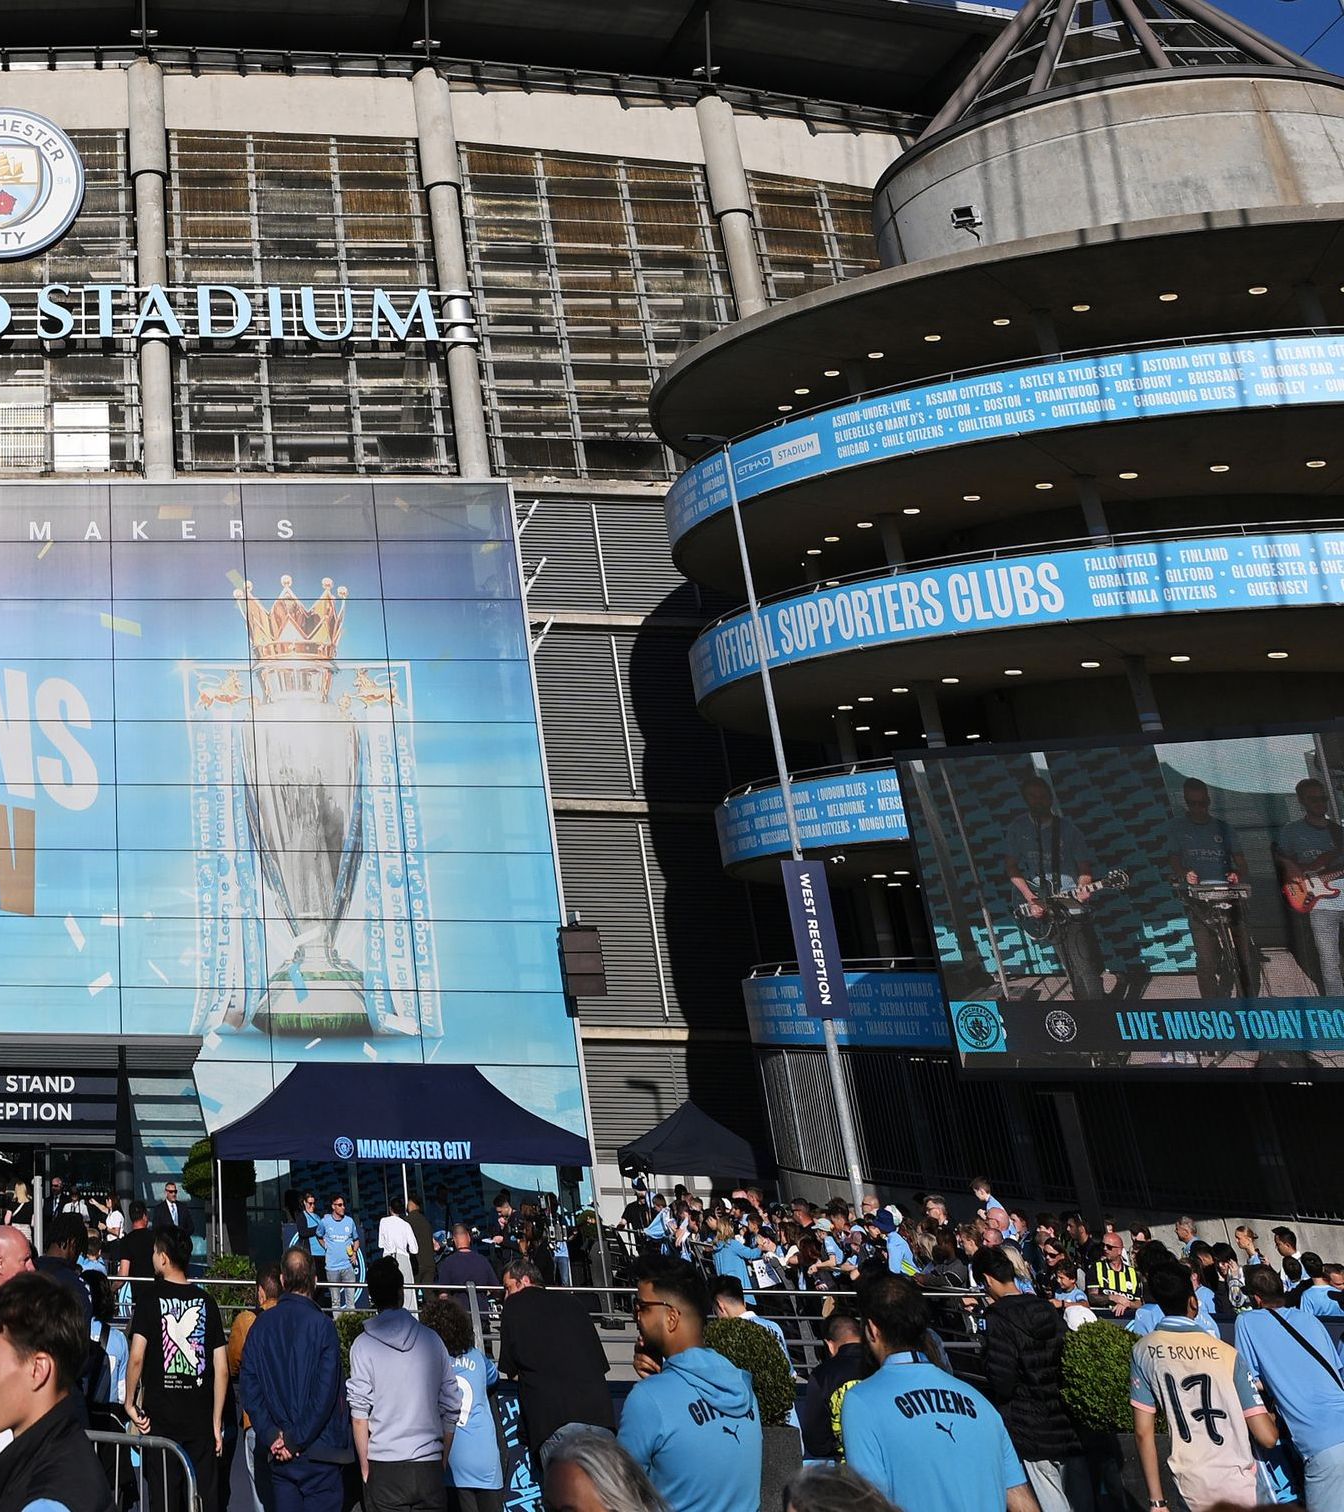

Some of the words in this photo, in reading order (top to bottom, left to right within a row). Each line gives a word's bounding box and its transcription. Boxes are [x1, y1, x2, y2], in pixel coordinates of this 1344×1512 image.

[35, 283, 441, 342] STADIUM
[832, 399, 911, 428] ASHTON-UNDER-LYNE
[925, 389, 958, 408] ASSAM
[959, 381, 1003, 401] CITYZENS
[1019, 372, 1055, 390] ASTLEY
[1058, 370, 1066, 384] &
[1067, 362, 1123, 383] TYLDESLEY
[1142, 356, 1189, 373] ASTORIA
[1192, 354, 1217, 368] CITY
[1220, 350, 1256, 366] BLUES
[1275, 344, 1325, 361] ATLANTA
[834, 423, 875, 445] BLUEBELLS
[884, 415, 908, 433] MARY
[936, 405, 971, 422] BOLTON
[983, 395, 1022, 412] BOSTON
[1035, 383, 1100, 404] BRANTWOOD
[1115, 375, 1172, 392] BREDBURY
[1188, 368, 1245, 385] BRISBANE
[1261, 363, 1307, 379] BROOKS
[1310, 362, 1334, 376] BAR
[837, 440, 871, 459] CHICAGO
[881, 431, 905, 449] CHILE
[958, 414, 1003, 434] CHILTERN
[1004, 408, 1036, 427] BLUES
[1051, 398, 1116, 419] CHITTAGONG
[1133, 390, 1197, 409] CHONGQING
[1200, 384, 1236, 401] BLUES
[1254, 381, 1306, 397] CHORLEY
[736, 455, 771, 477] ETIHAD
[777, 440, 815, 461] STADIUM
[28, 519, 296, 541] MAKERS
[1084, 552, 1158, 572] FALLOWFIELD
[1179, 547, 1229, 564] FINLAND
[1251, 543, 1301, 559] FLIXTON
[1088, 571, 1149, 590] GIBRALTAR
[1165, 567, 1214, 583] GILFORD
[1232, 561, 1306, 579] GLOUCESTER
[1092, 589, 1159, 608] GUATEMALA
[1163, 585, 1218, 602] CITYZENS
[1247, 580, 1309, 597] GUERNSEY
[777, 577, 945, 656] SUPPORTERS
[948, 562, 1065, 624] CLUBS
[196, 732, 210, 793] League
[376, 735, 391, 794] League
[397, 736, 412, 797] League
[845, 782, 868, 797] BLUES
[199, 797, 212, 859] Premier
[383, 799, 398, 859] Premier
[402, 802, 419, 865] Premier
[822, 820, 851, 836] CITYZENS
[826, 800, 866, 818] MELBOURNE
[799, 873, 817, 916] WEST
[199, 893, 215, 957] League
[390, 894, 406, 960] League
[412, 899, 428, 966] League
[209, 951, 232, 1013] Premier
[807, 919, 833, 1006] RECEPTION
[415, 969, 433, 1027] Premier
[1116, 1011, 1163, 1040] LIVE
[1162, 1011, 1235, 1040] MUSIC
[1235, 1009, 1304, 1039] TODAY
[894, 1021, 920, 1036] VALLEY
[6, 1075, 76, 1094] STAND
[356, 1138, 441, 1160] MANCHESTER
[443, 1141, 471, 1160] CITY
[1147, 1344, 1165, 1359] DE
[1167, 1345, 1221, 1361] BRUYNE
[894, 1388, 977, 1419] CITYZENS
[1164, 1371, 1227, 1446] 17
